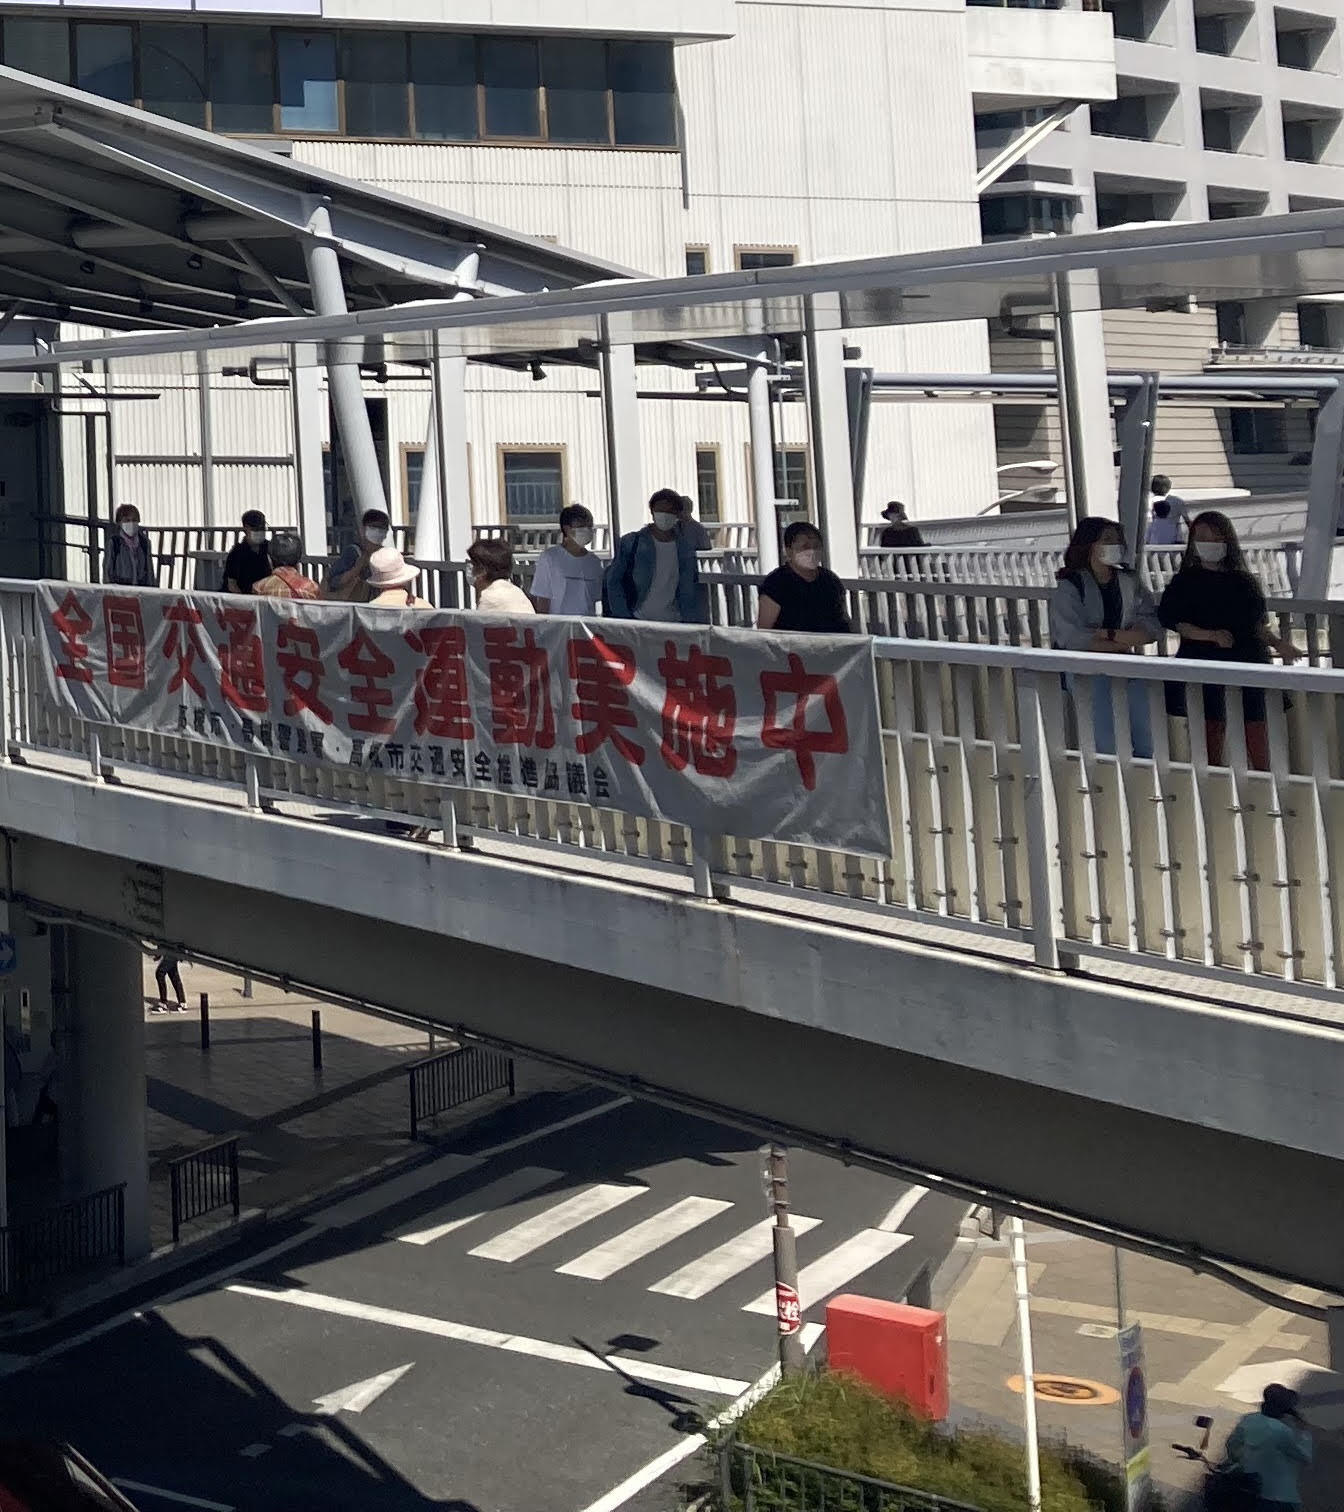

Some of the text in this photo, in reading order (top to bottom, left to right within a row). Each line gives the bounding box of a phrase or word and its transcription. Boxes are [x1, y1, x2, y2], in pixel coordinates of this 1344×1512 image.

[51, 589, 848, 791] 全国交通安全運動実施中
